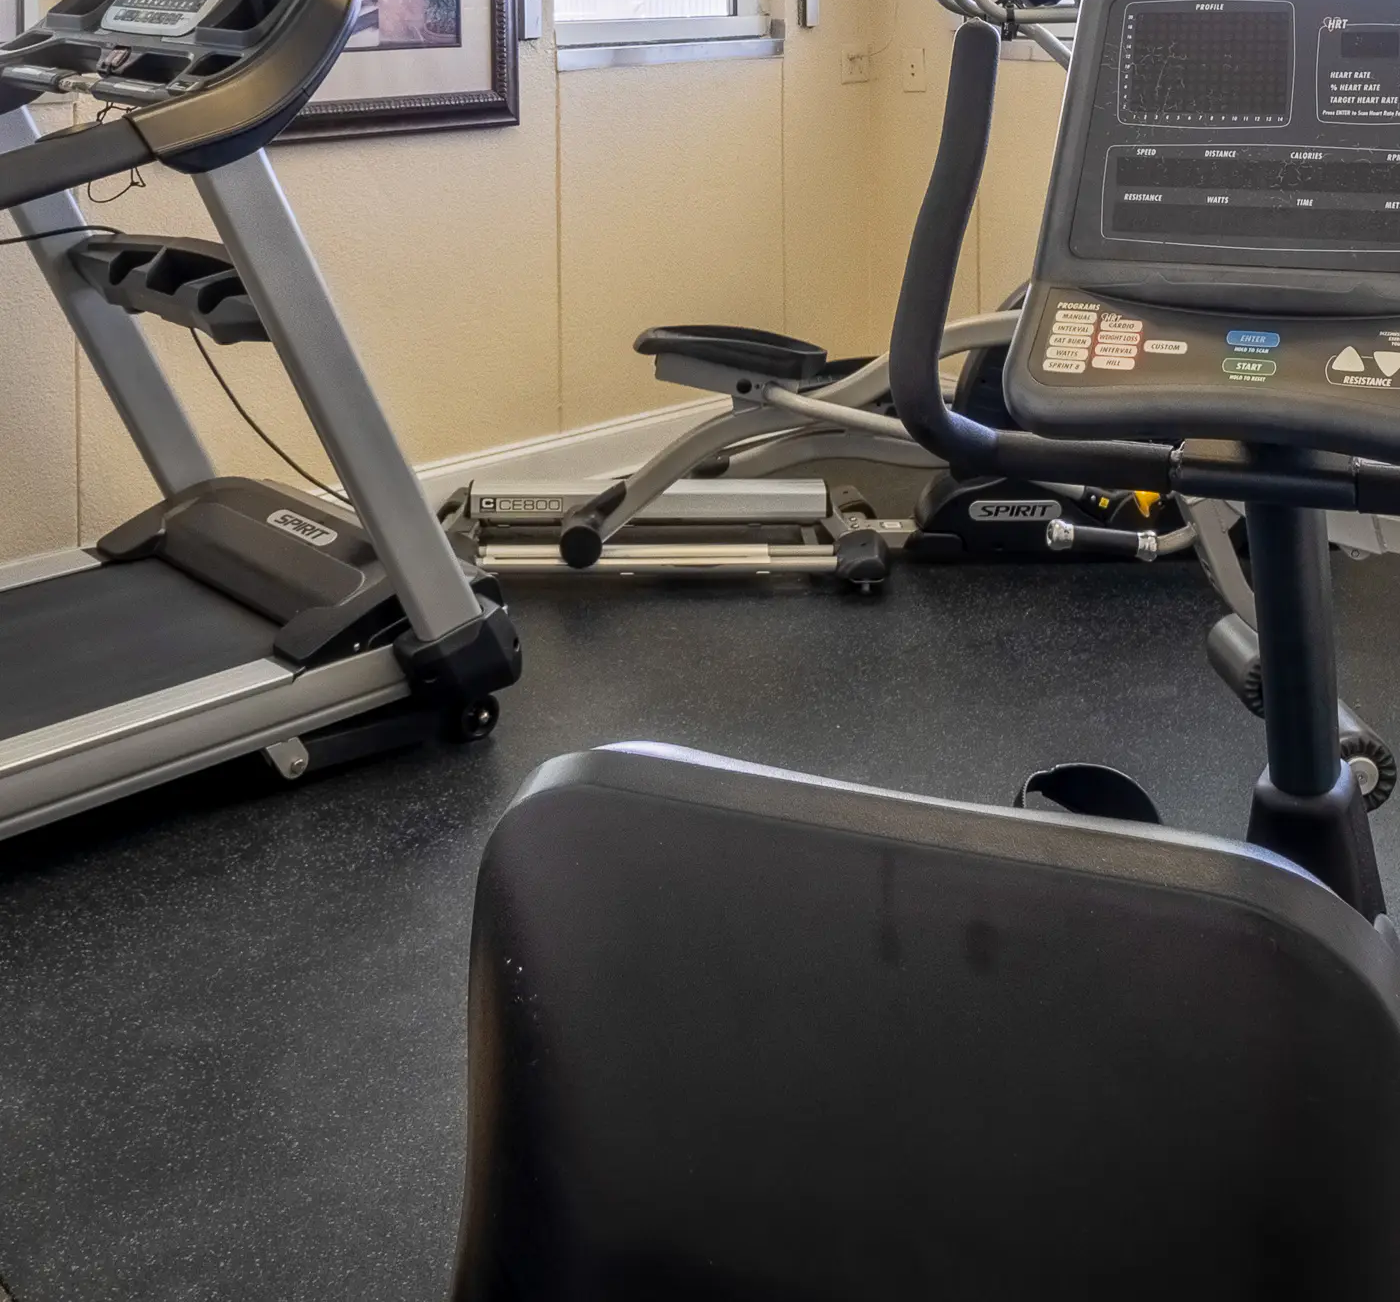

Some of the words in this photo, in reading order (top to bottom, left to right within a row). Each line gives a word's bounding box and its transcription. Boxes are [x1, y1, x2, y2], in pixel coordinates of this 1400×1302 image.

[1195, 3, 1225, 11] PROFILE
[1327, 19, 1349, 29] HRT
[1330, 71, 1352, 79] HEART
[1354, 71, 1371, 79] RATE
[1136, 148, 1156, 156] SPEED
[1204, 150, 1236, 158] DISTANCE
[1290, 152, 1323, 160] CALORIES
[1124, 193, 1162, 202] RESISTANCE
[1207, 196, 1229, 204] WATTS
[1296, 199, 1313, 207] TIME
[1057, 302, 1100, 311] PROGRAMS
[1058, 325, 1089, 333] INTERVAL
[1108, 322, 1135, 330] CARDIO
[1240, 334, 1266, 343] ENTER
[1100, 346, 1132, 354] INTERVAL
[1048, 361, 1073, 369] SPRINT
[1236, 362, 1262, 371] START
[1343, 375, 1392, 387] RESISTANCE
[499, 499, 560, 510] CE800
[978, 505, 1054, 517] SPIRIT
[274, 514, 330, 539] SPIRIT
